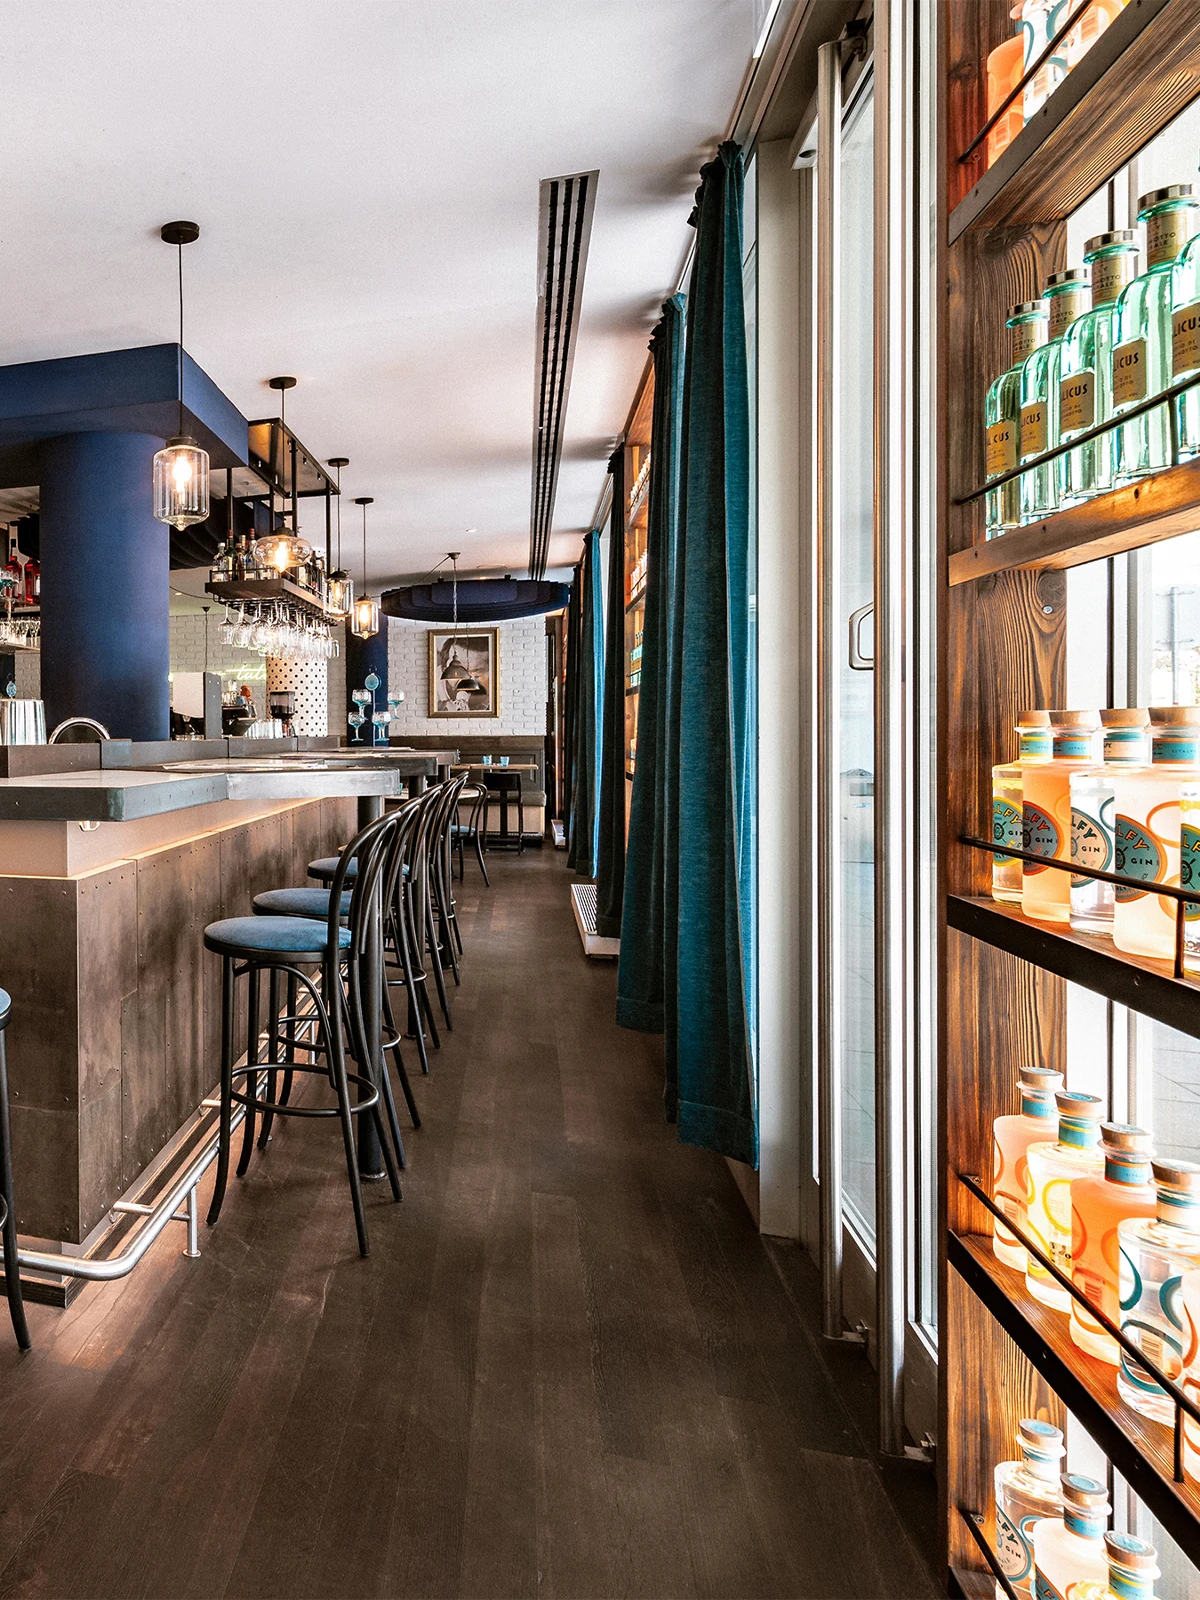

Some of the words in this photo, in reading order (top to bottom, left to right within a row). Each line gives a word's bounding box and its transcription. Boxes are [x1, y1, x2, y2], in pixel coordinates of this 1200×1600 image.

[1071, 815, 1098, 840] LFY
[1116, 823, 1151, 851] LFY
[1081, 845, 1100, 853] GIN
[1130, 857, 1153, 866] GIN
[1005, 1545, 1022, 1559] GIN
